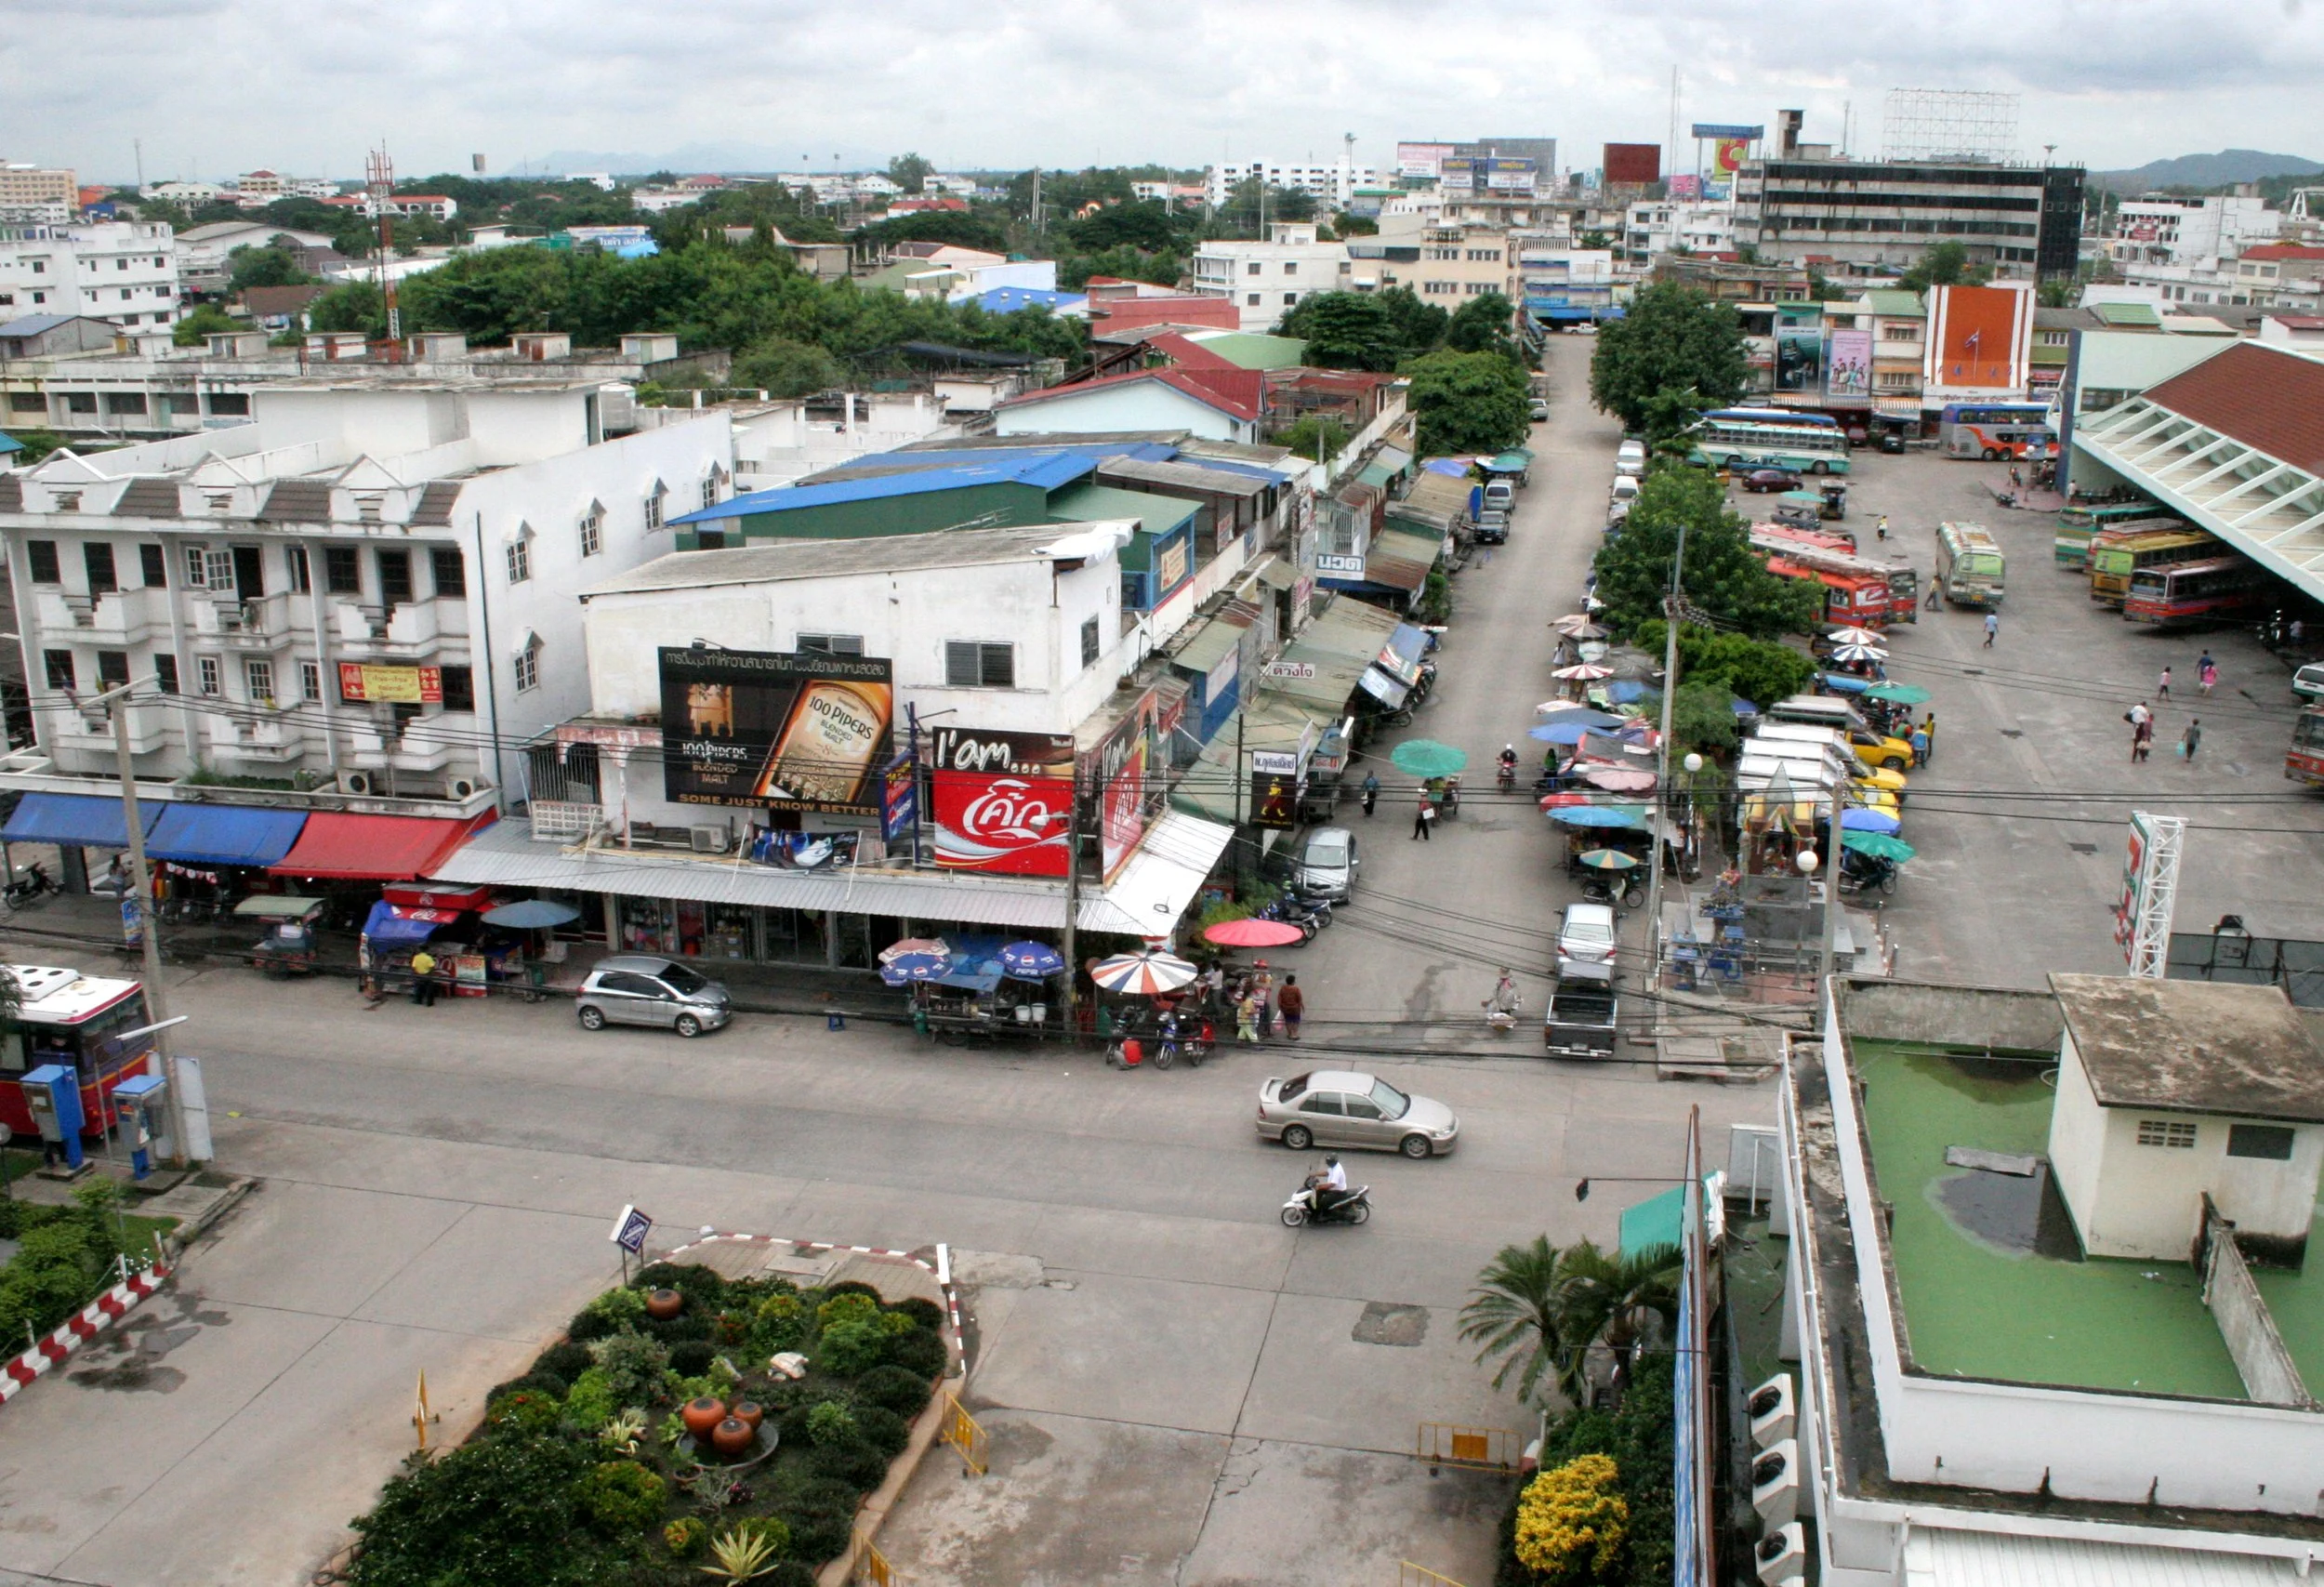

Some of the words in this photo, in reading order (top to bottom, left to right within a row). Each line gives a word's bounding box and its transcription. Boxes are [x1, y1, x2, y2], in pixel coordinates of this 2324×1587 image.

[1318, 555, 1362, 571] นวด
[810, 695, 831, 716] 100
[830, 707, 874, 739] PIPERS
[820, 720, 852, 741] BLENDED
[682, 743, 705, 757] 100
[706, 744, 747, 760] PIPERS
[700, 773, 730, 785] MALT
[679, 793, 721, 805] SOME
[726, 797, 763, 808] JUST
[769, 800, 814, 813] KNOW
[820, 803, 879, 816] BETTER
